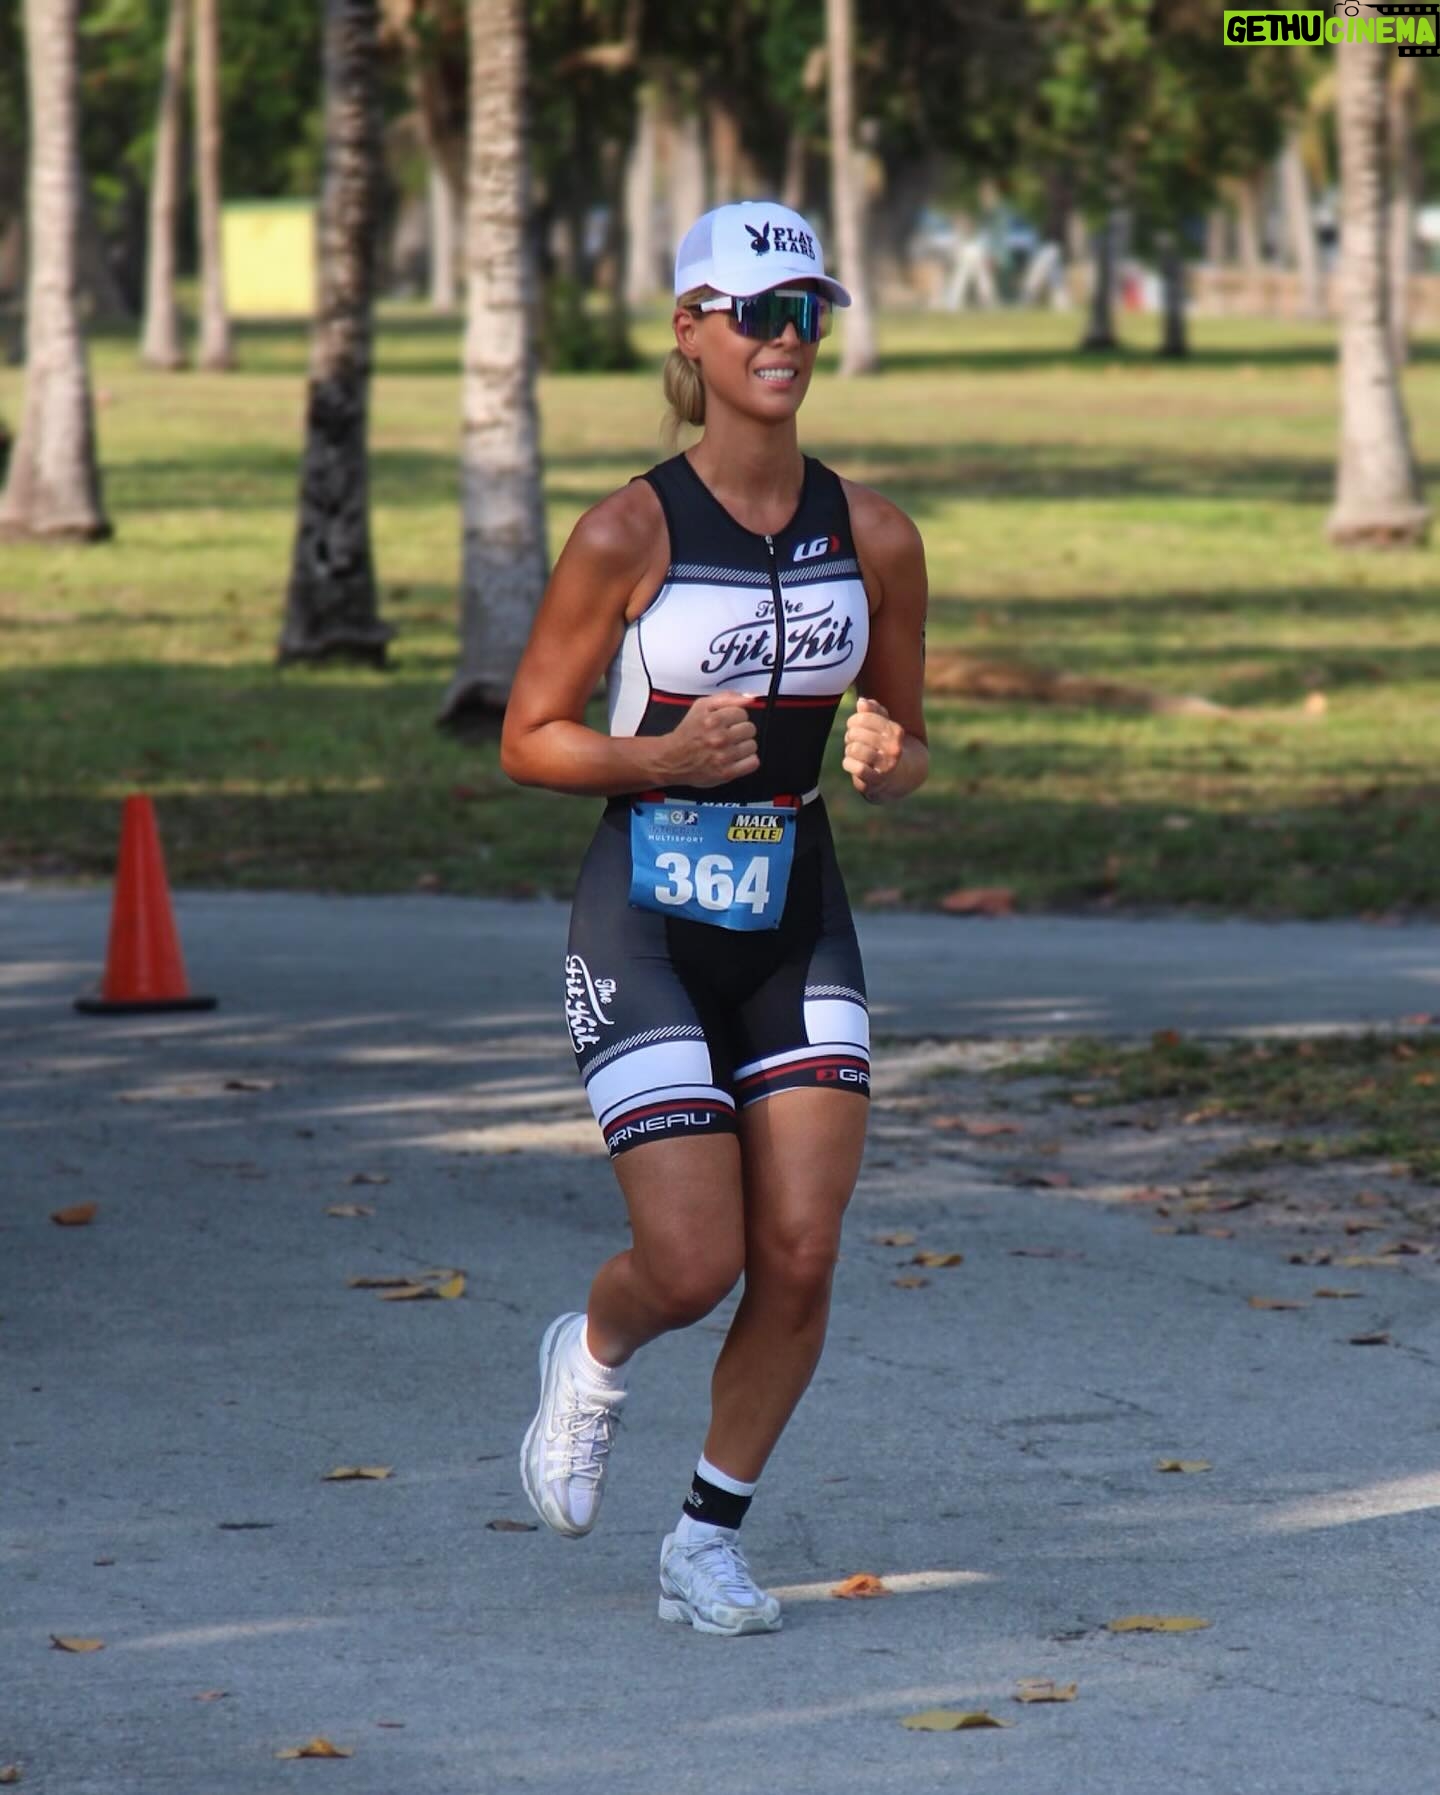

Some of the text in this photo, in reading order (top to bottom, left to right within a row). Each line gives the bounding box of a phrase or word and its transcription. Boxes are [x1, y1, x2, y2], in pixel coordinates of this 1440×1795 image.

[772, 227, 813, 247] PLAY
[774, 240, 816, 260] HARD
[701, 615, 854, 673] Fit Kit
[735, 814, 778, 828] MACK
[648, 834, 704, 843] MULTISPORT
[732, 828, 777, 840] CYCLE
[655, 852, 769, 914] 364
[594, 978, 617, 1005] The
[566, 999, 600, 1045] Kit
